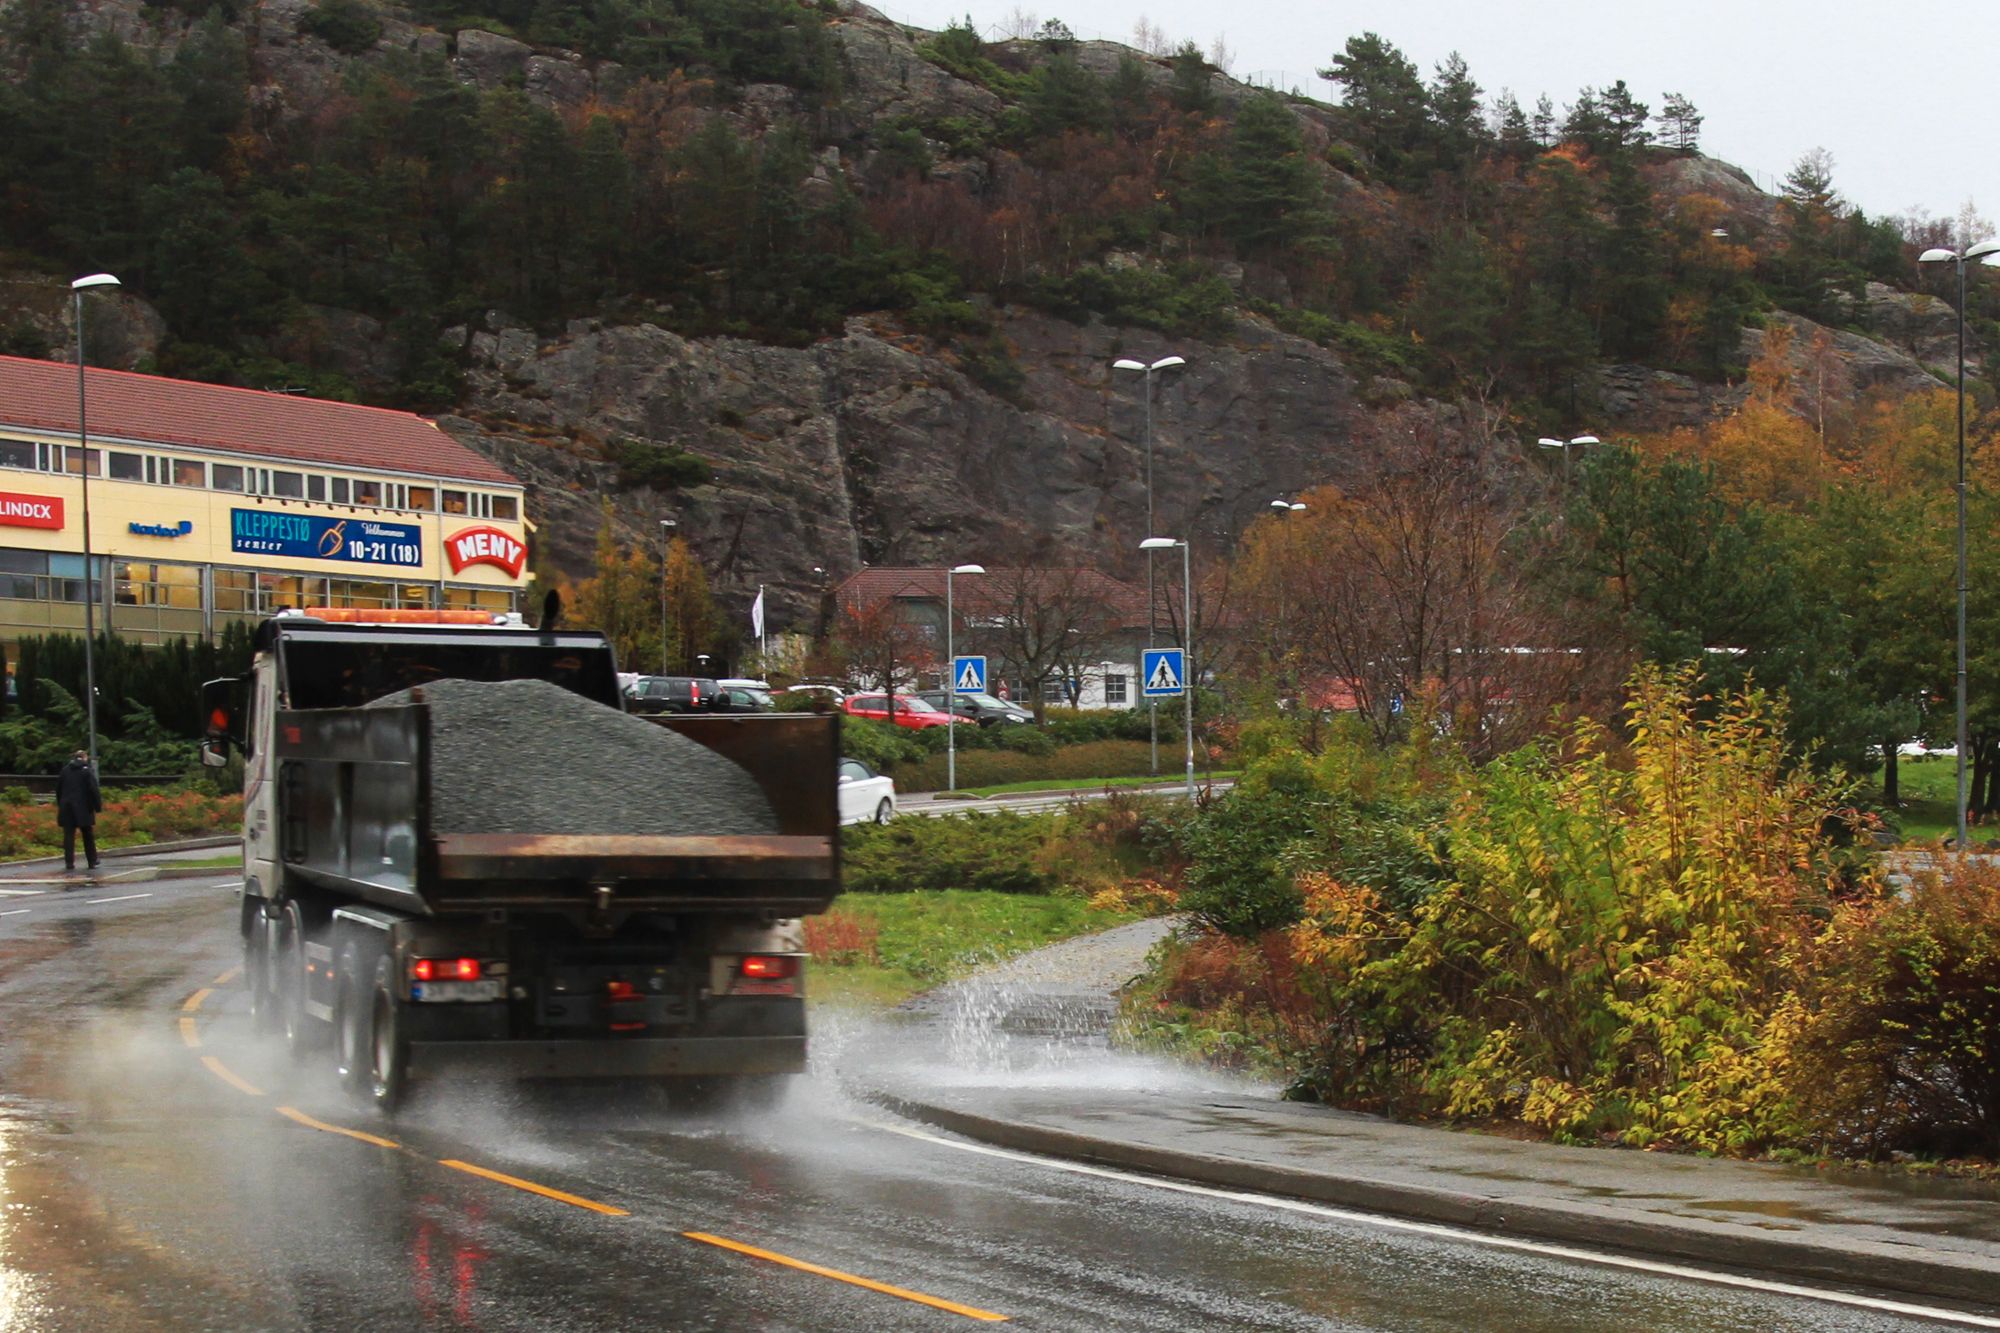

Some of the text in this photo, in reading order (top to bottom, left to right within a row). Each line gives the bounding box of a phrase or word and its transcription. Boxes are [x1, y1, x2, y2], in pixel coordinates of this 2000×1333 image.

[0, 501, 52, 520] LINDEX
[235, 512, 310, 542] KLEPPESTØ
[361, 522, 406, 538] Velkommen
[236, 540, 282, 551] senter
[349, 540, 419, 564] 10-21 (18)
[456, 533, 522, 565] MENY
